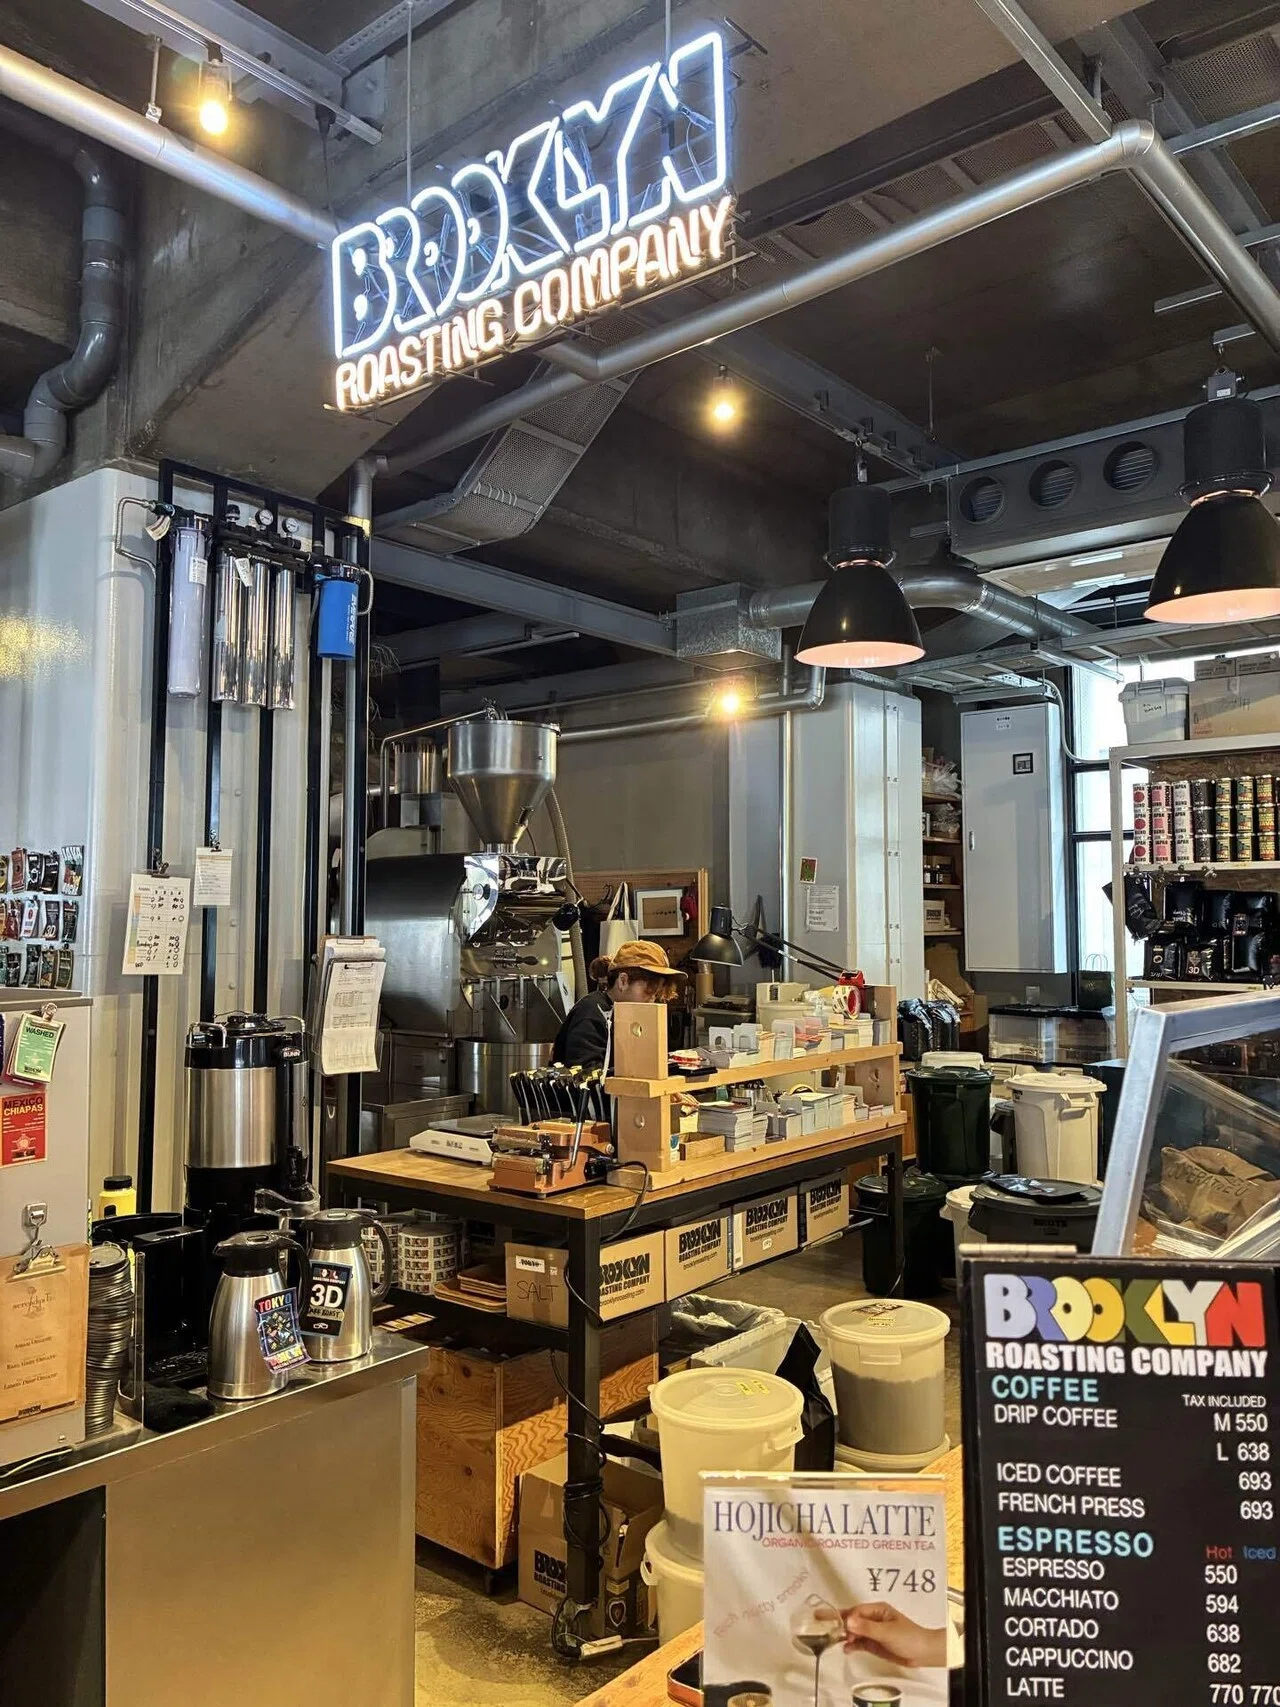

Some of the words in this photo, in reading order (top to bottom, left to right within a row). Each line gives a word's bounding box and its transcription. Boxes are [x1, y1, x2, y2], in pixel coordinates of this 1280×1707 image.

[334, 298, 505, 411] ROASTING
[514, 195, 732, 335] COMPANY
[25, 1026, 55, 1039] WASHED
[4, 1096, 44, 1109] MEXICO
[4, 1104, 44, 1116] CHIAPAS
[746, 1197, 788, 1228] BROOKLYN
[679, 1219, 721, 1254] BROOKLYN
[600, 1252, 650, 1288] ROOKLYN
[310, 1283, 344, 1308] 3D
[517, 1274, 559, 1303] SALT
[600, 1282, 623, 1296] ASTING
[623, 1274, 650, 1290] COMPANY
[259, 1293, 292, 1312] TOKYO
[983, 1274, 1266, 1347] BROOKLYN
[985, 1342, 1126, 1375] ROASTING
[1131, 1346, 1268, 1378] COMPANY
[991, 1375, 1100, 1402] COFFEE
[1182, 1394, 1206, 1408] TAX
[1207, 1395, 1266, 1408] INCLUDED
[994, 1404, 1038, 1424] DRIP
[1042, 1406, 1118, 1429] COFFEE
[1214, 1414, 1231, 1432] M
[1235, 1413, 1268, 1433] 550
[1217, 1442, 1229, 1461] L
[1237, 1442, 1270, 1462] 638
[997, 1462, 1041, 1484] ICED
[1045, 1464, 1122, 1488] COFFEE
[1238, 1471, 1272, 1491] 693
[998, 1492, 1076, 1514] FRENCH
[1081, 1496, 1146, 1519] PRESS
[1240, 1500, 1274, 1520] 693
[713, 1501, 836, 1541] HOJICHA
[843, 1504, 936, 1537] LATTE
[762, 1537, 816, 1549] ORGANIC
[818, 1538, 870, 1550] ROASTED
[872, 1539, 912, 1550] GREEN
[914, 1540, 936, 1551] TEA
[998, 1526, 1154, 1557] ESPRESSO
[1205, 1545, 1233, 1560] Hot
[1243, 1546, 1277, 1560] Iced
[1002, 1557, 1105, 1580] ESPRESSO
[1204, 1565, 1238, 1584] 550
[867, 1567, 936, 1594] ¥748
[1004, 1587, 1119, 1611] MACCHIATO
[1205, 1594, 1239, 1614] 594
[1005, 1617, 1099, 1639] CORTADO
[1206, 1624, 1240, 1643] 638
[1005, 1647, 1133, 1671] CAPPUCCINO
[1207, 1653, 1242, 1674] 682
[1006, 1677, 1065, 1698] LATTE
[1209, 1684, 1244, 1704] 770
[1250, 1686, 1280, 1707] 770
